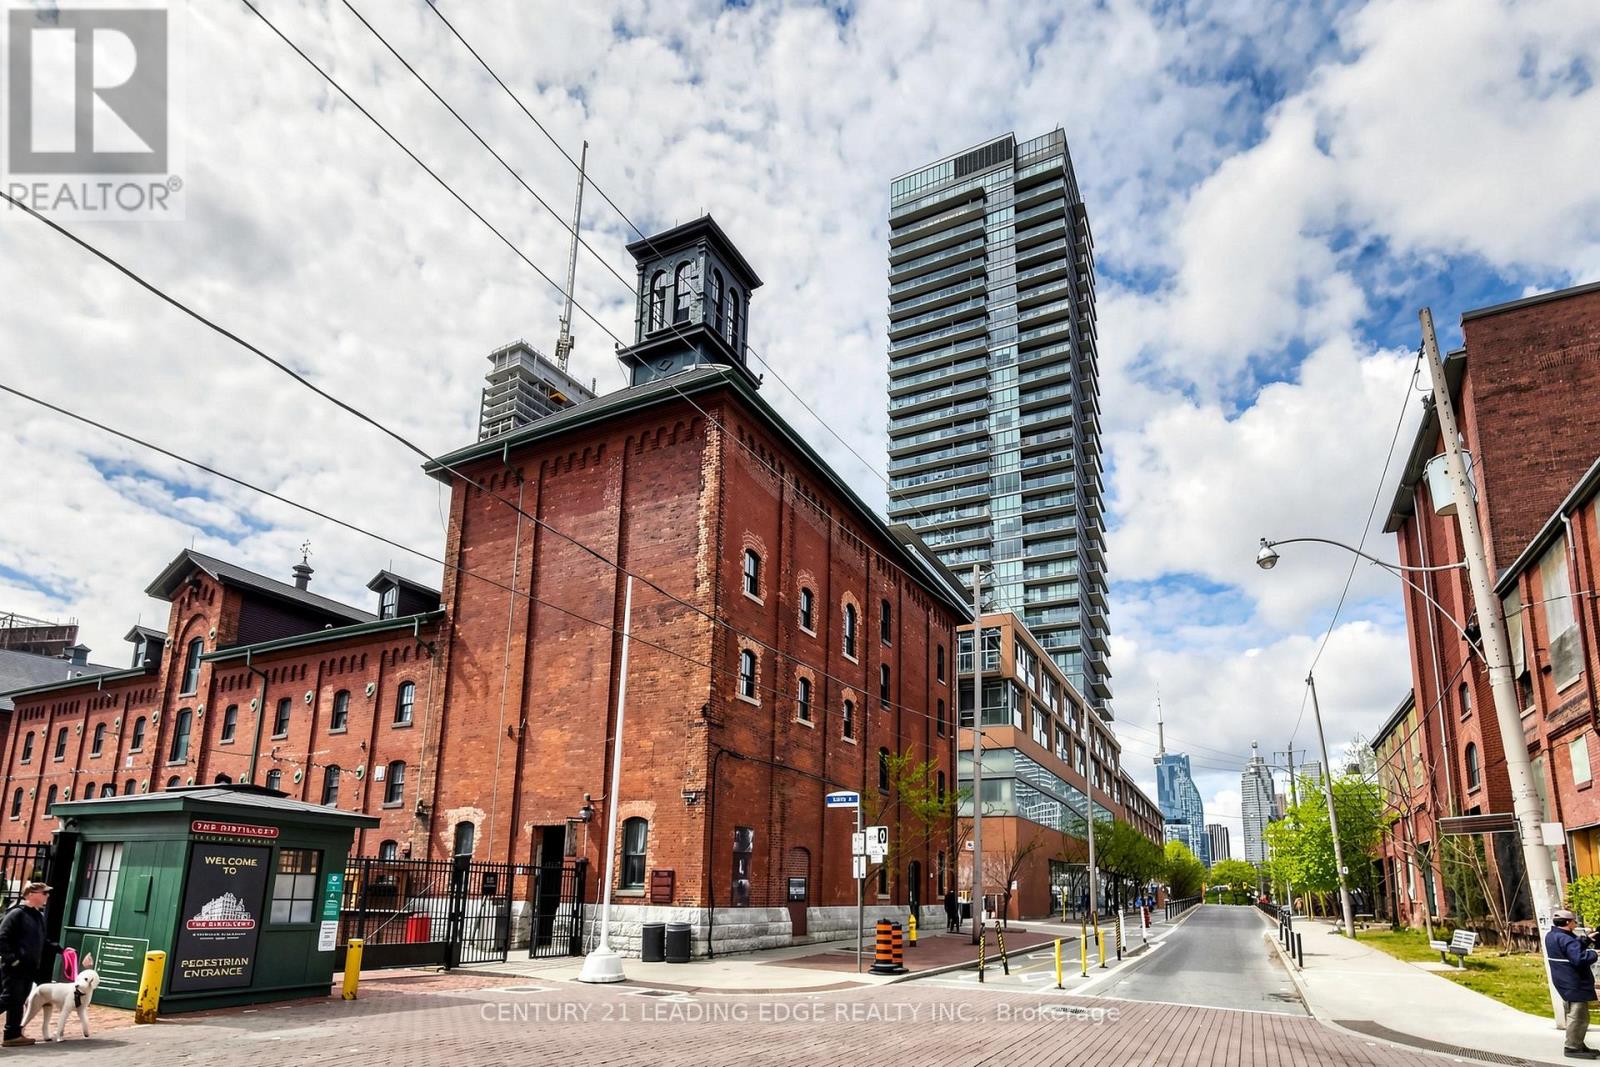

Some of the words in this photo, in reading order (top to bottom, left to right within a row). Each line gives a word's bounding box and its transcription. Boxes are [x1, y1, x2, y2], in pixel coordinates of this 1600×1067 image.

[204, 856, 258, 867] WELCOME
[222, 866, 237, 875] TO
[181, 957, 249, 968] PEDESTRIAN
[183, 967, 244, 978] ENTRANCE
